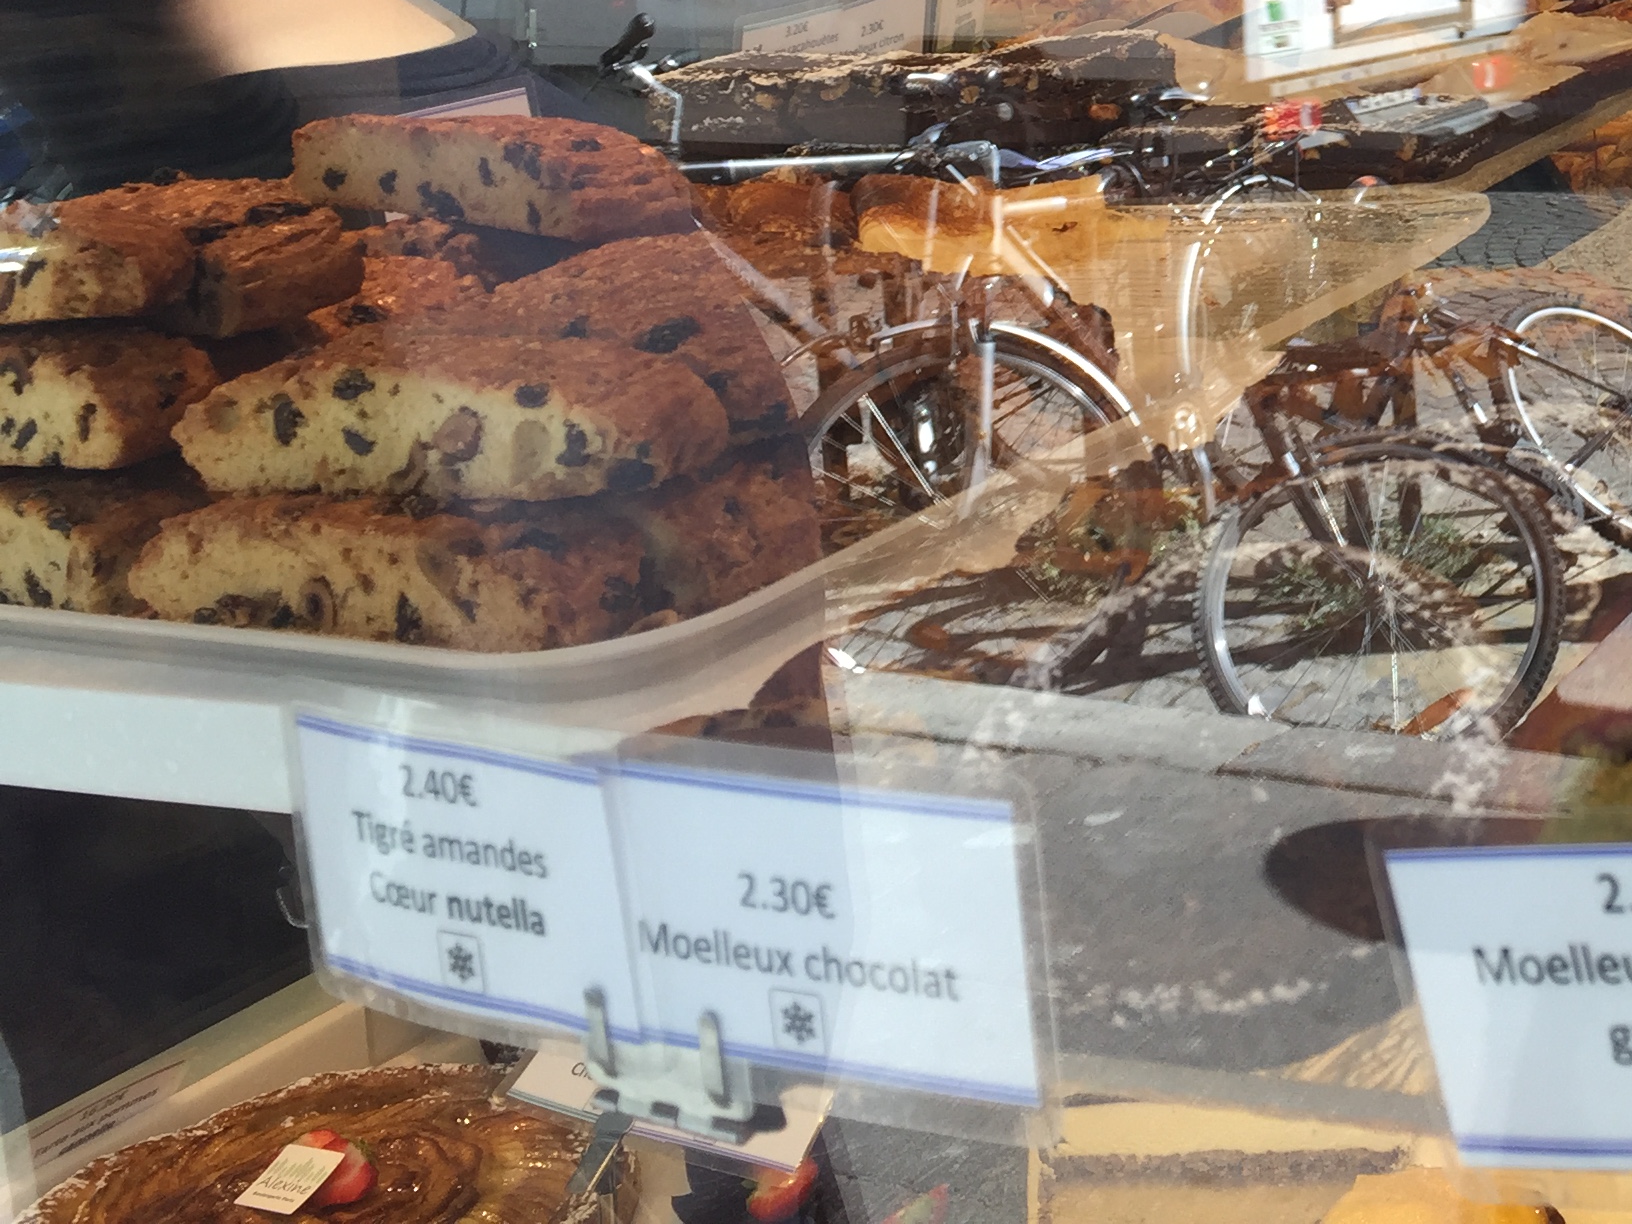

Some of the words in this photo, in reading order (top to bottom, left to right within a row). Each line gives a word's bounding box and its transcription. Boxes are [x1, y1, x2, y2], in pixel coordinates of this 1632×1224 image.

[400, 763, 478, 808] 2.40€
[351, 810, 414, 856] Tigré
[421, 831, 549, 881] amandes
[370, 870, 438, 917] Cœur
[446, 892, 547, 938] nutella
[737, 872, 836, 920] 2.30€
[637, 918, 793, 978] Moelleux
[803, 947, 961, 1002] chocolat
[257, 1175, 312, 1196] Alexine
